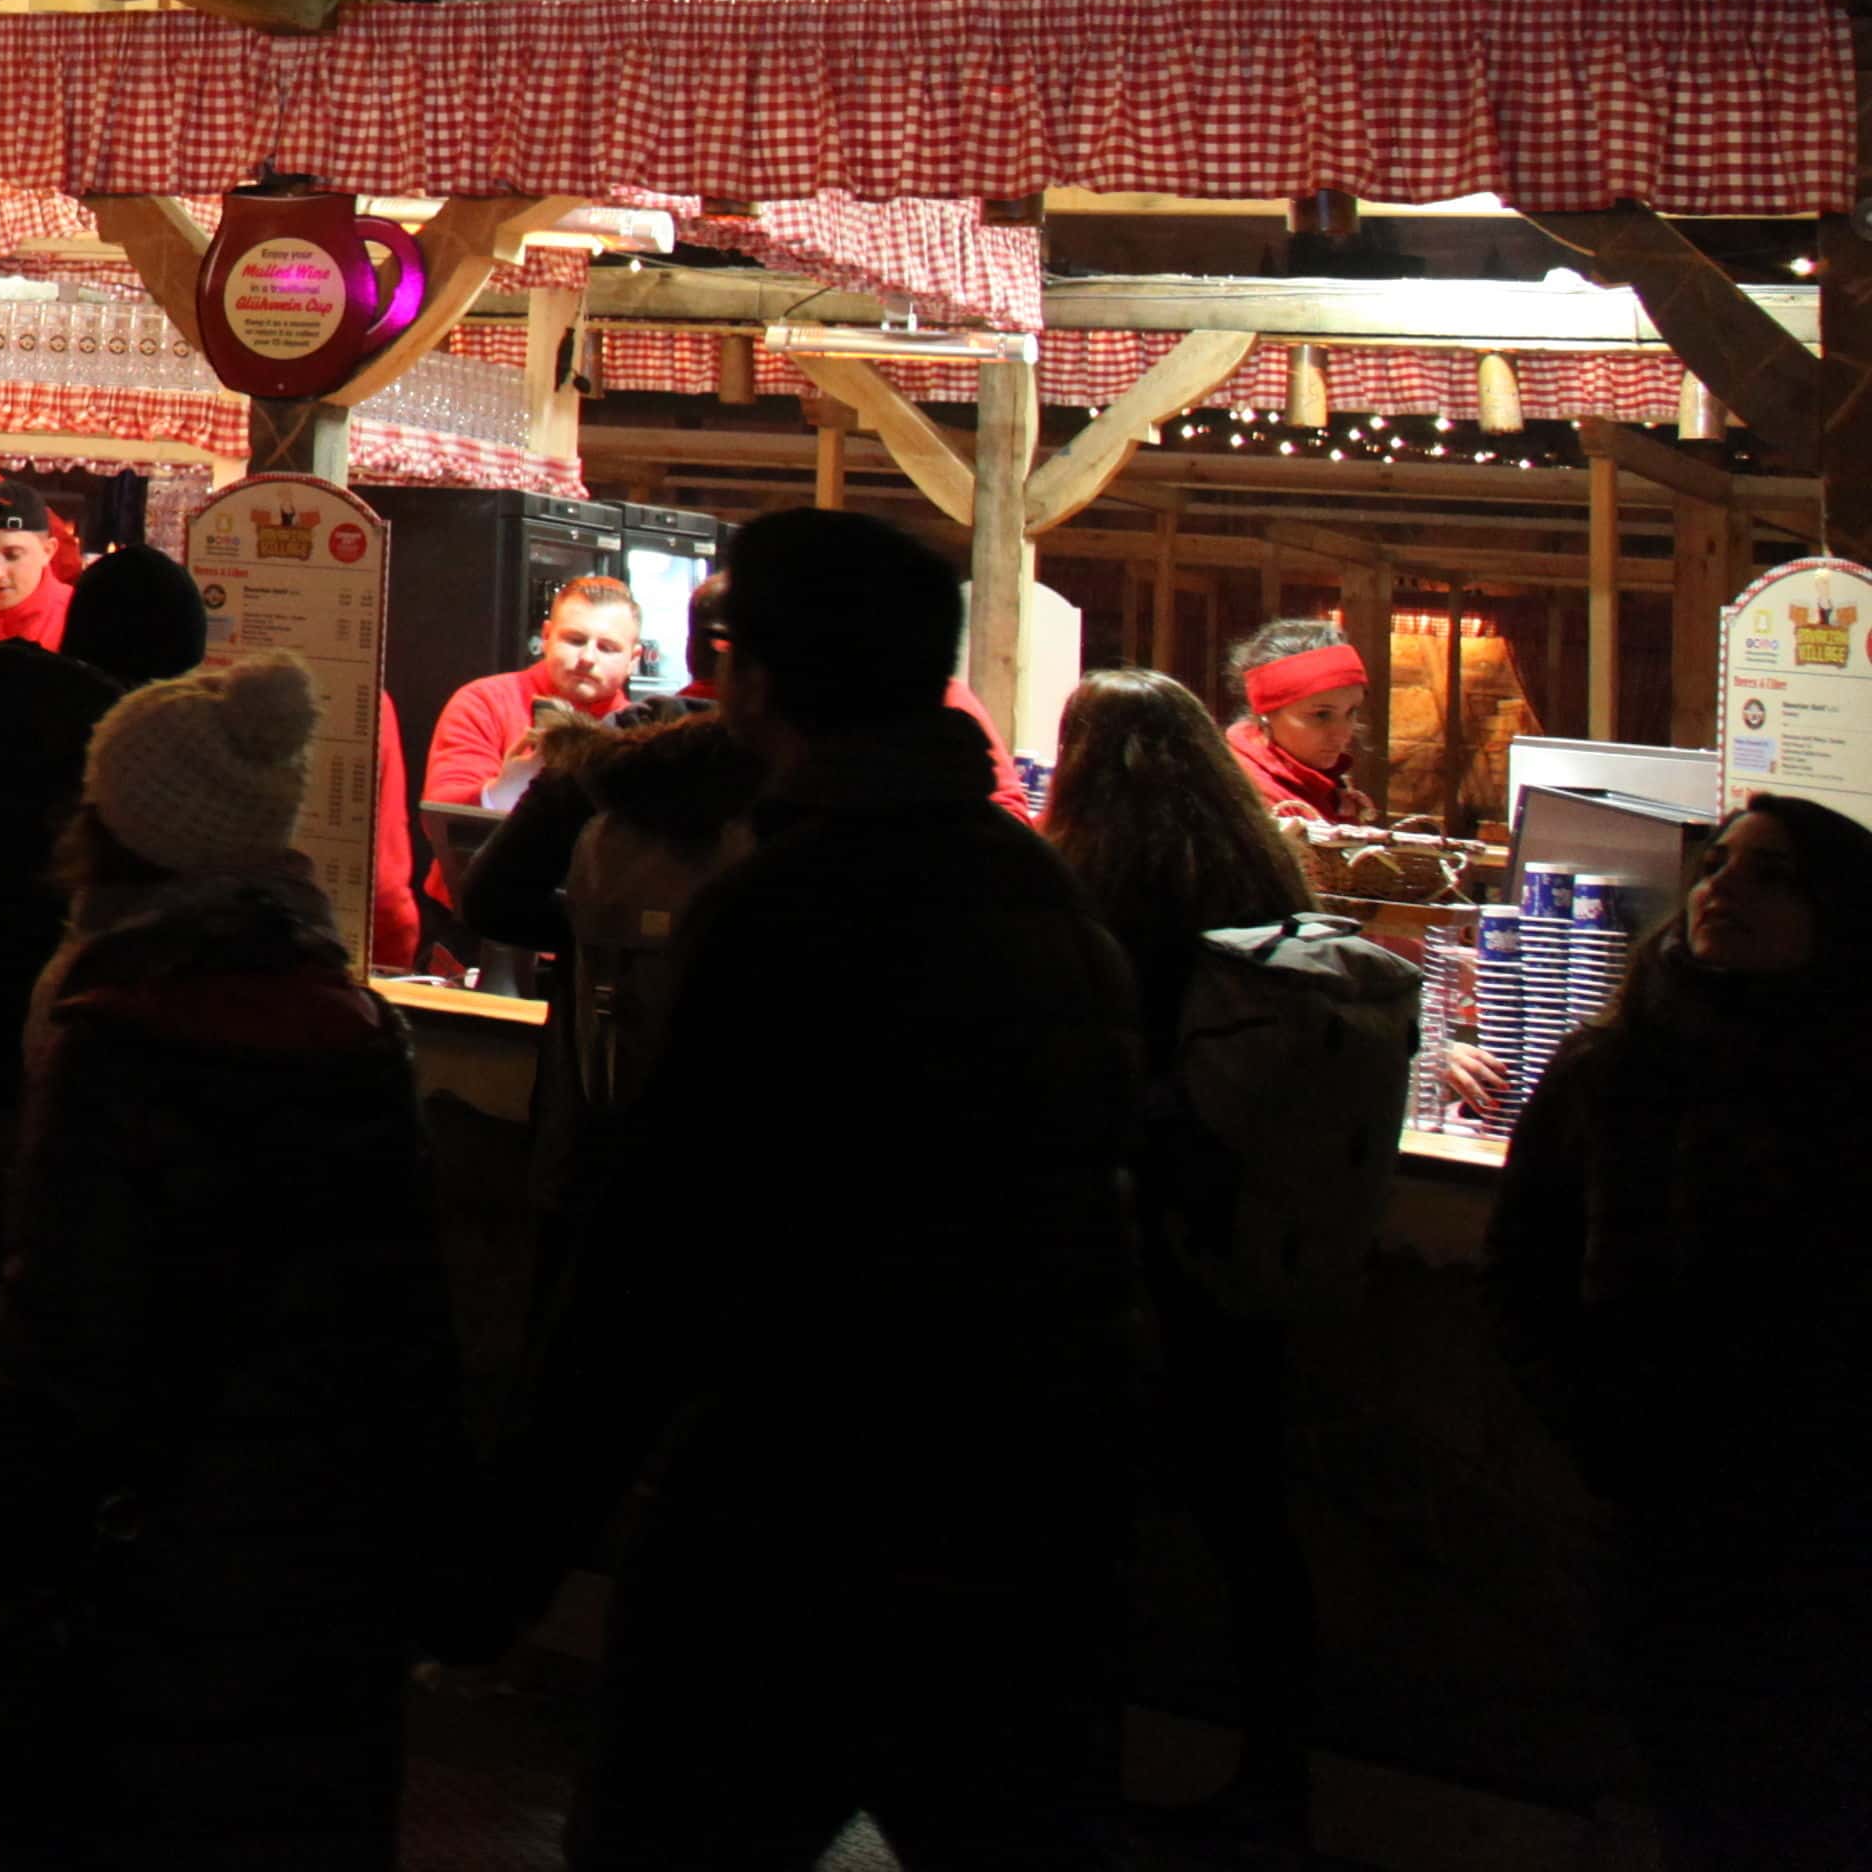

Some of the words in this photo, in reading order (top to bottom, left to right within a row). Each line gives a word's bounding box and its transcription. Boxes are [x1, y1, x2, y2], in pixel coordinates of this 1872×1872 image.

[242, 263, 295, 279] Mulled
[297, 263, 331, 280] Wine
[304, 296, 333, 317] Cup
